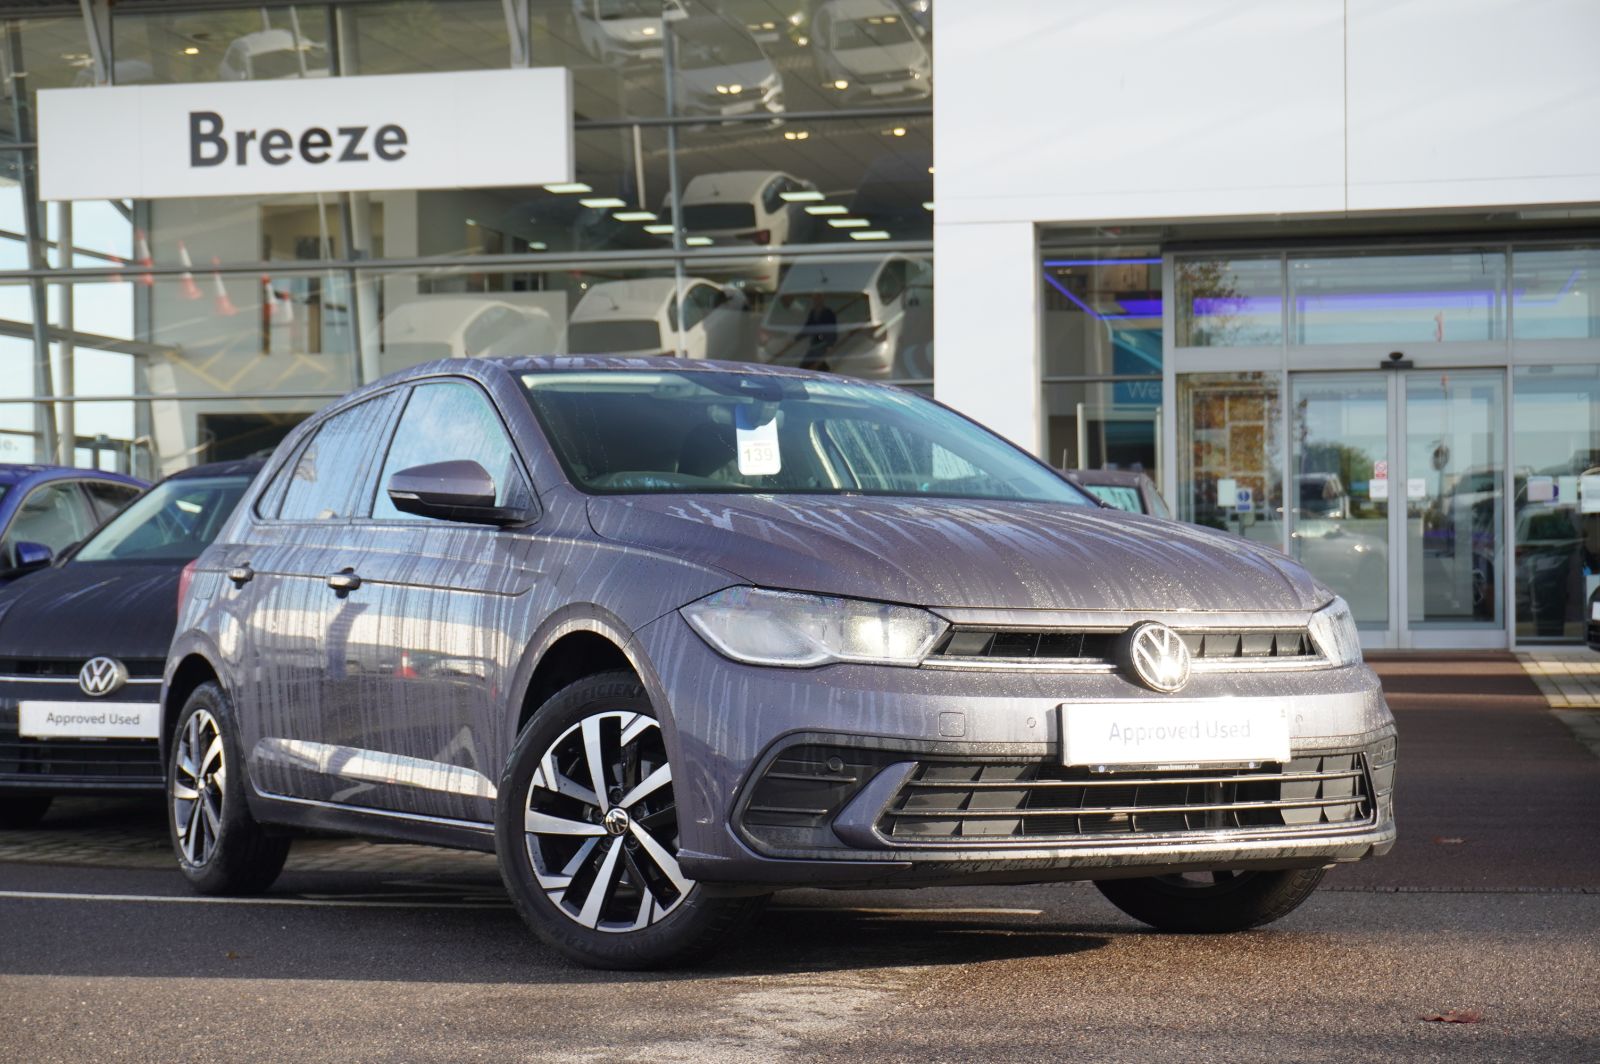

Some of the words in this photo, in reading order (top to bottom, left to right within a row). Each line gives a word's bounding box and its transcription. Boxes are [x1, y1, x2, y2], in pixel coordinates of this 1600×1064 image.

[189, 110, 408, 168] Breeze
[46, 712, 106, 726] Approved
[109, 713, 140, 725] Used
[1108, 720, 1200, 746] Approved
[1205, 719, 1251, 739] Used
